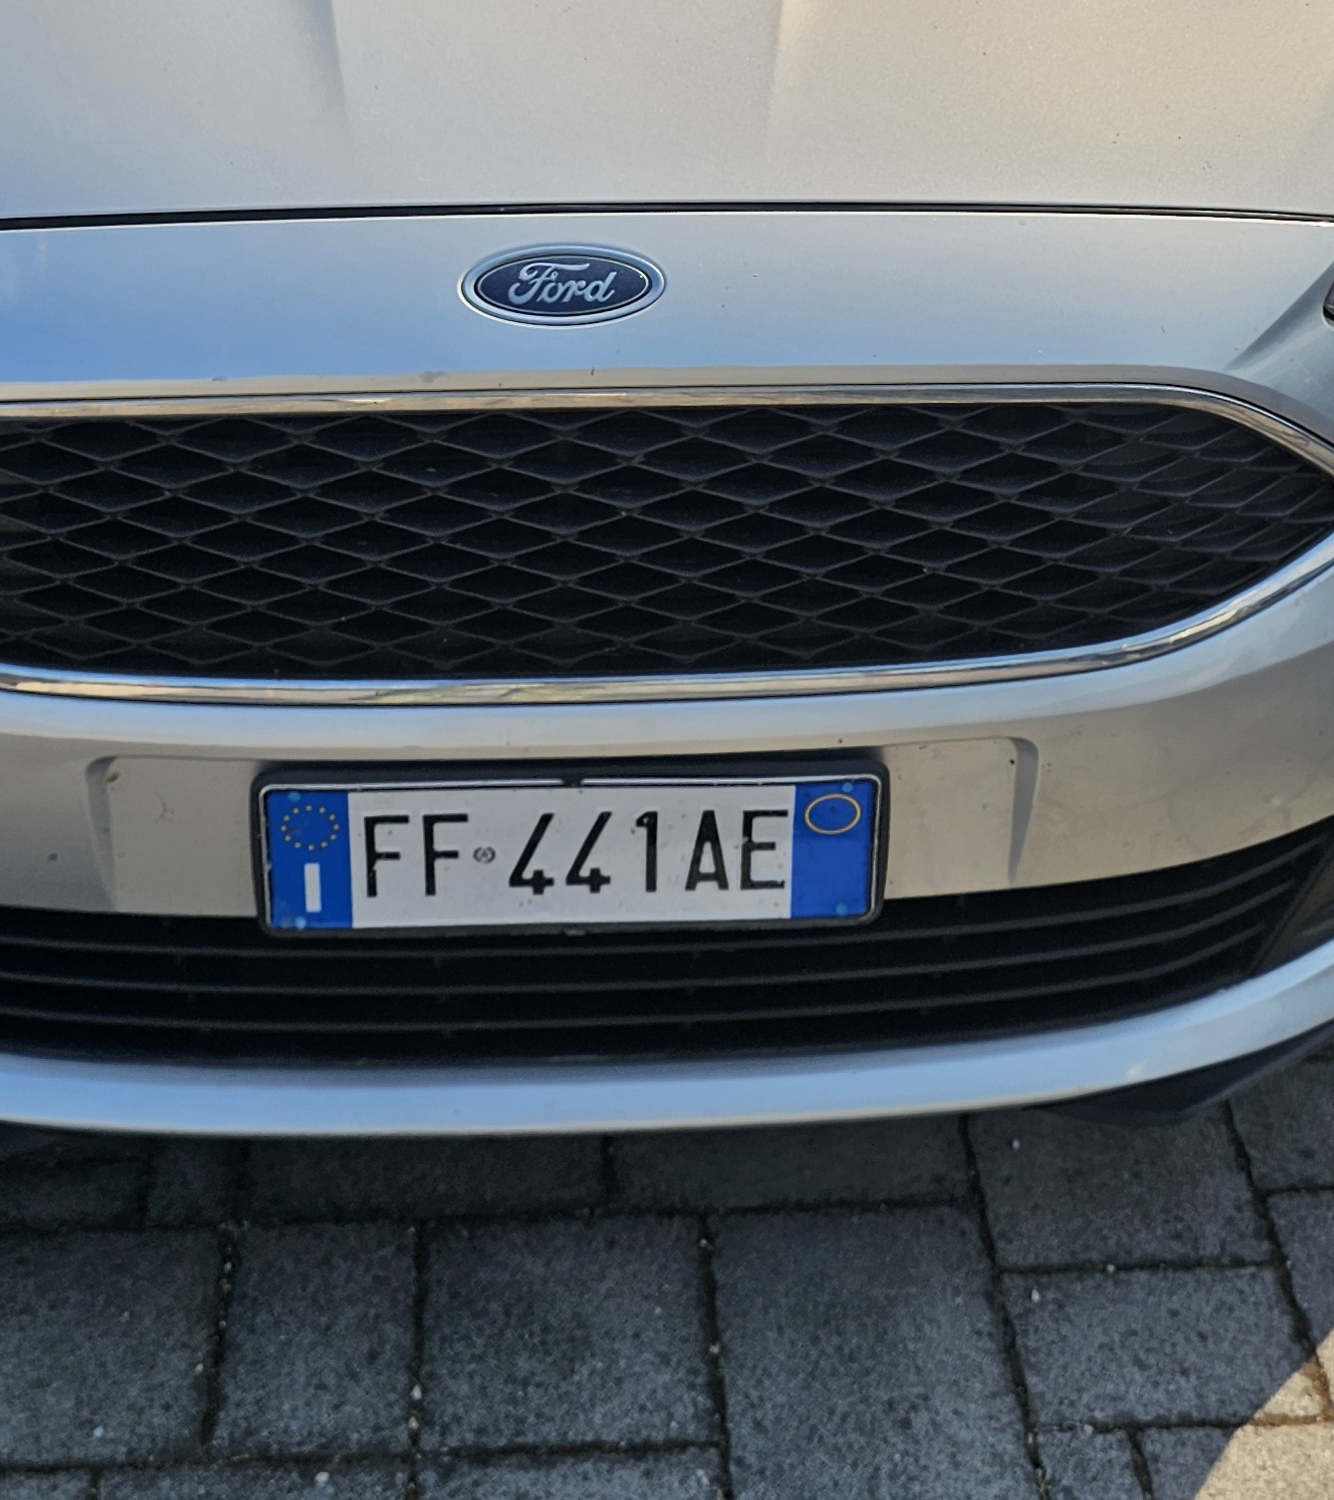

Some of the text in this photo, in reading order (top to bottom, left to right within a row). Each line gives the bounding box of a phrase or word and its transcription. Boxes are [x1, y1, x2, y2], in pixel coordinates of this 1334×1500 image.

[508, 262, 617, 305] Ford
[363, 812, 469, 898] FF
[508, 808, 790, 895] 441AE
